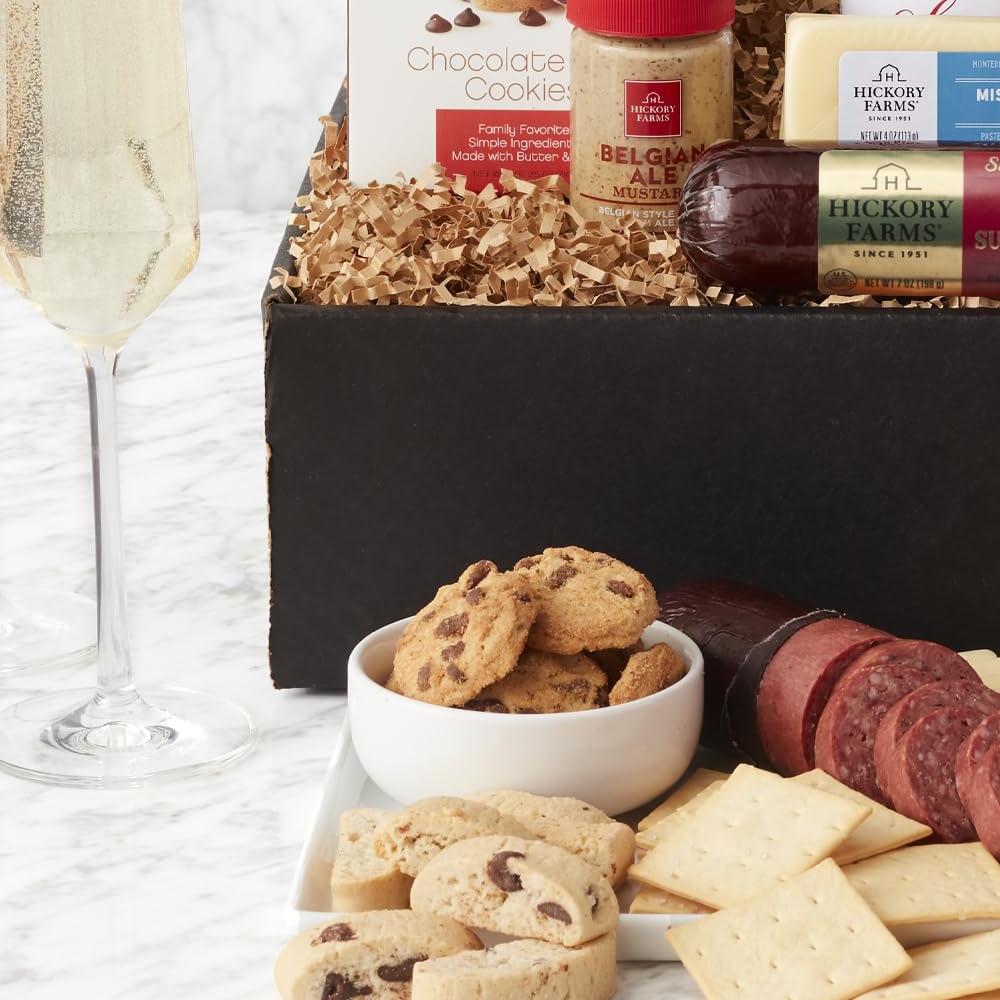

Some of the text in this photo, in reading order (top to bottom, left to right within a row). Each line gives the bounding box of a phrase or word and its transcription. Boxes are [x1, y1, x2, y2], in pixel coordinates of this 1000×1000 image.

[406, 46, 565, 73] Chocolate
[853, 86, 925, 98] HICKORY
[630, 105, 675, 114] HICKORY
[864, 100, 916, 112] FARMS
[637, 114, 670, 122] FARMS
[478, 123, 570, 137] Family Favorite
[468, 137, 571, 151] Simple Ingredient
[452, 150, 570, 162] Made with Butter &
[600, 143, 705, 166] BELGIAN
[629, 167, 677, 187] ALE
[612, 186, 682, 200] MUSTAR
[643, 210, 675, 218] STYLE
[828, 198, 954, 218] HICKORY
[654, 219, 675, 227] ALE
[846, 221, 938, 243] FARMS
[854, 250, 928, 258] SINCE 1951
